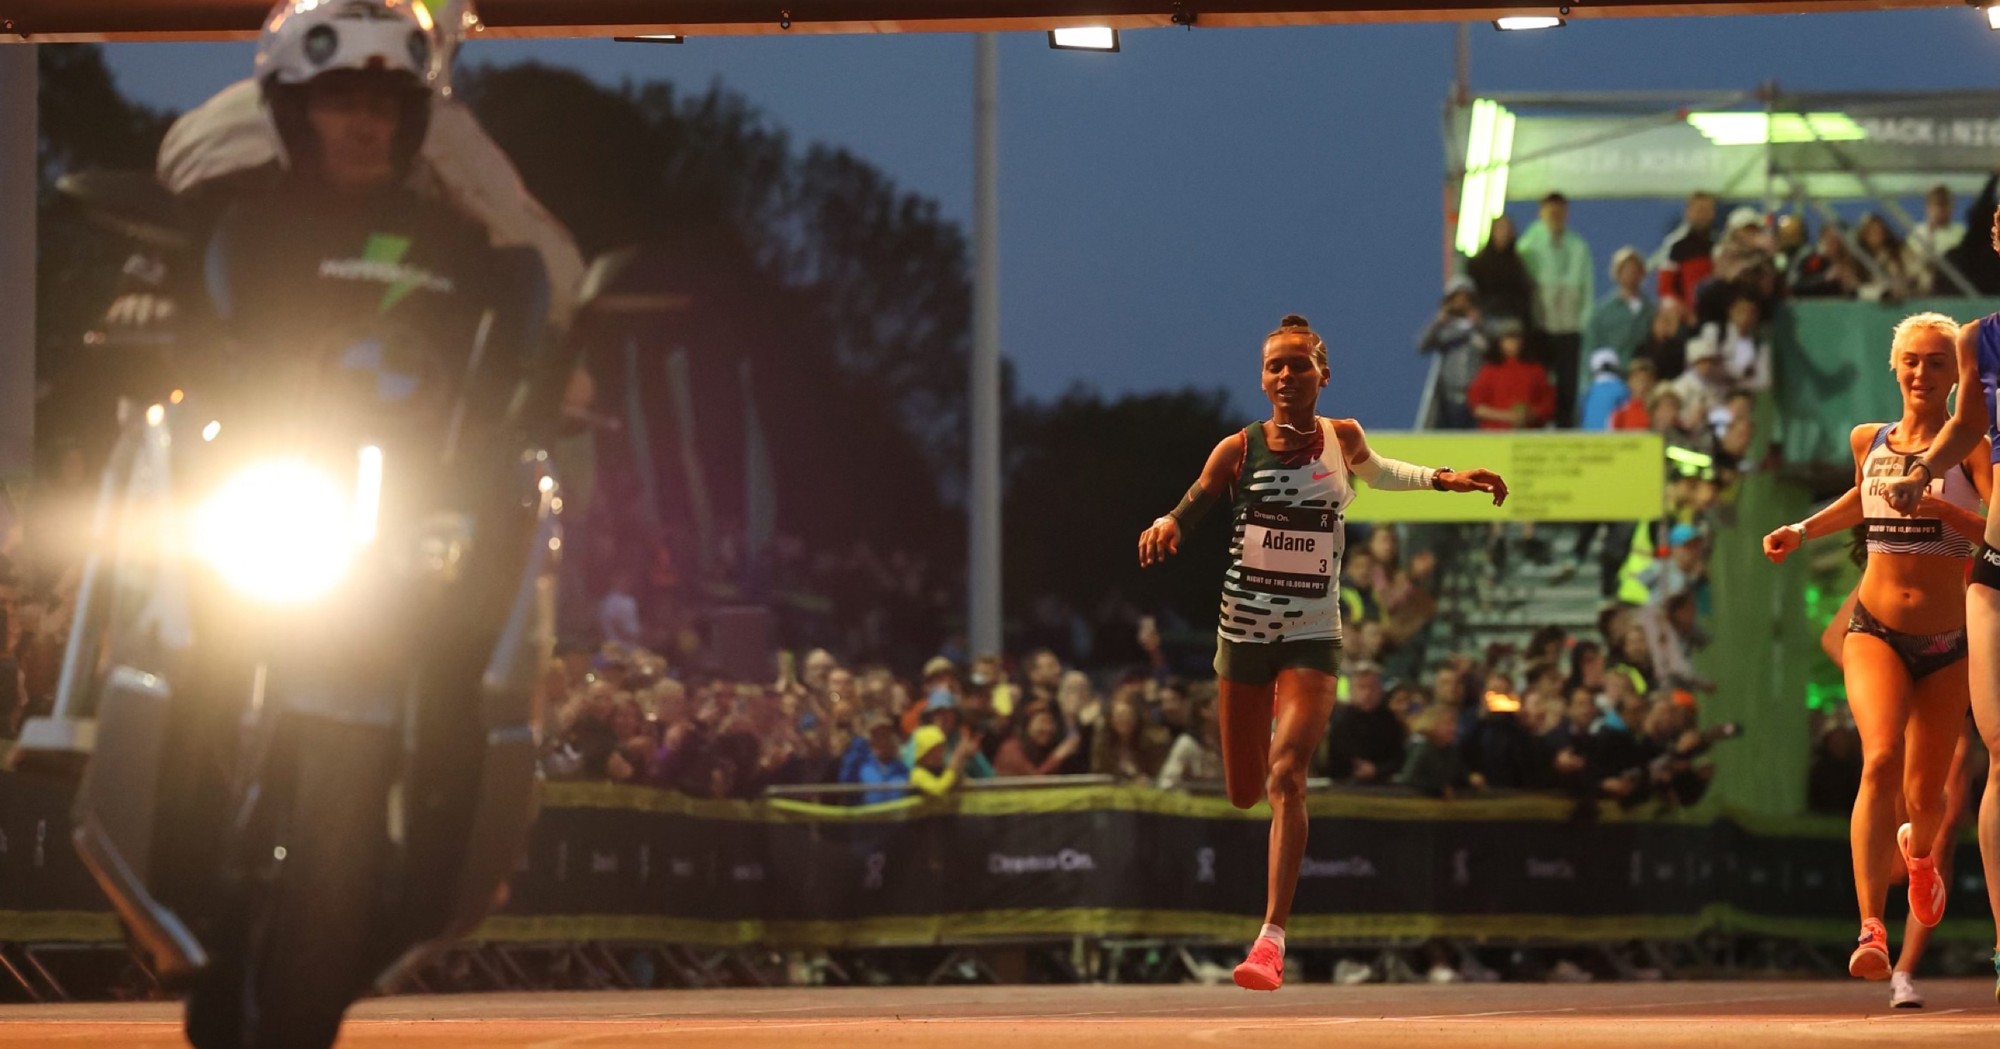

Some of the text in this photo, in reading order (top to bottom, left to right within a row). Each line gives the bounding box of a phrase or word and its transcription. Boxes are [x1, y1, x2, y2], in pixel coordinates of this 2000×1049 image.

[1255, 511, 1276, 520] Dream
[1262, 530, 1316, 552] Adane
[1319, 559, 1328, 574] 3
[1246, 575, 1264, 584] NIGHT
[1273, 579, 1285, 587] THE
